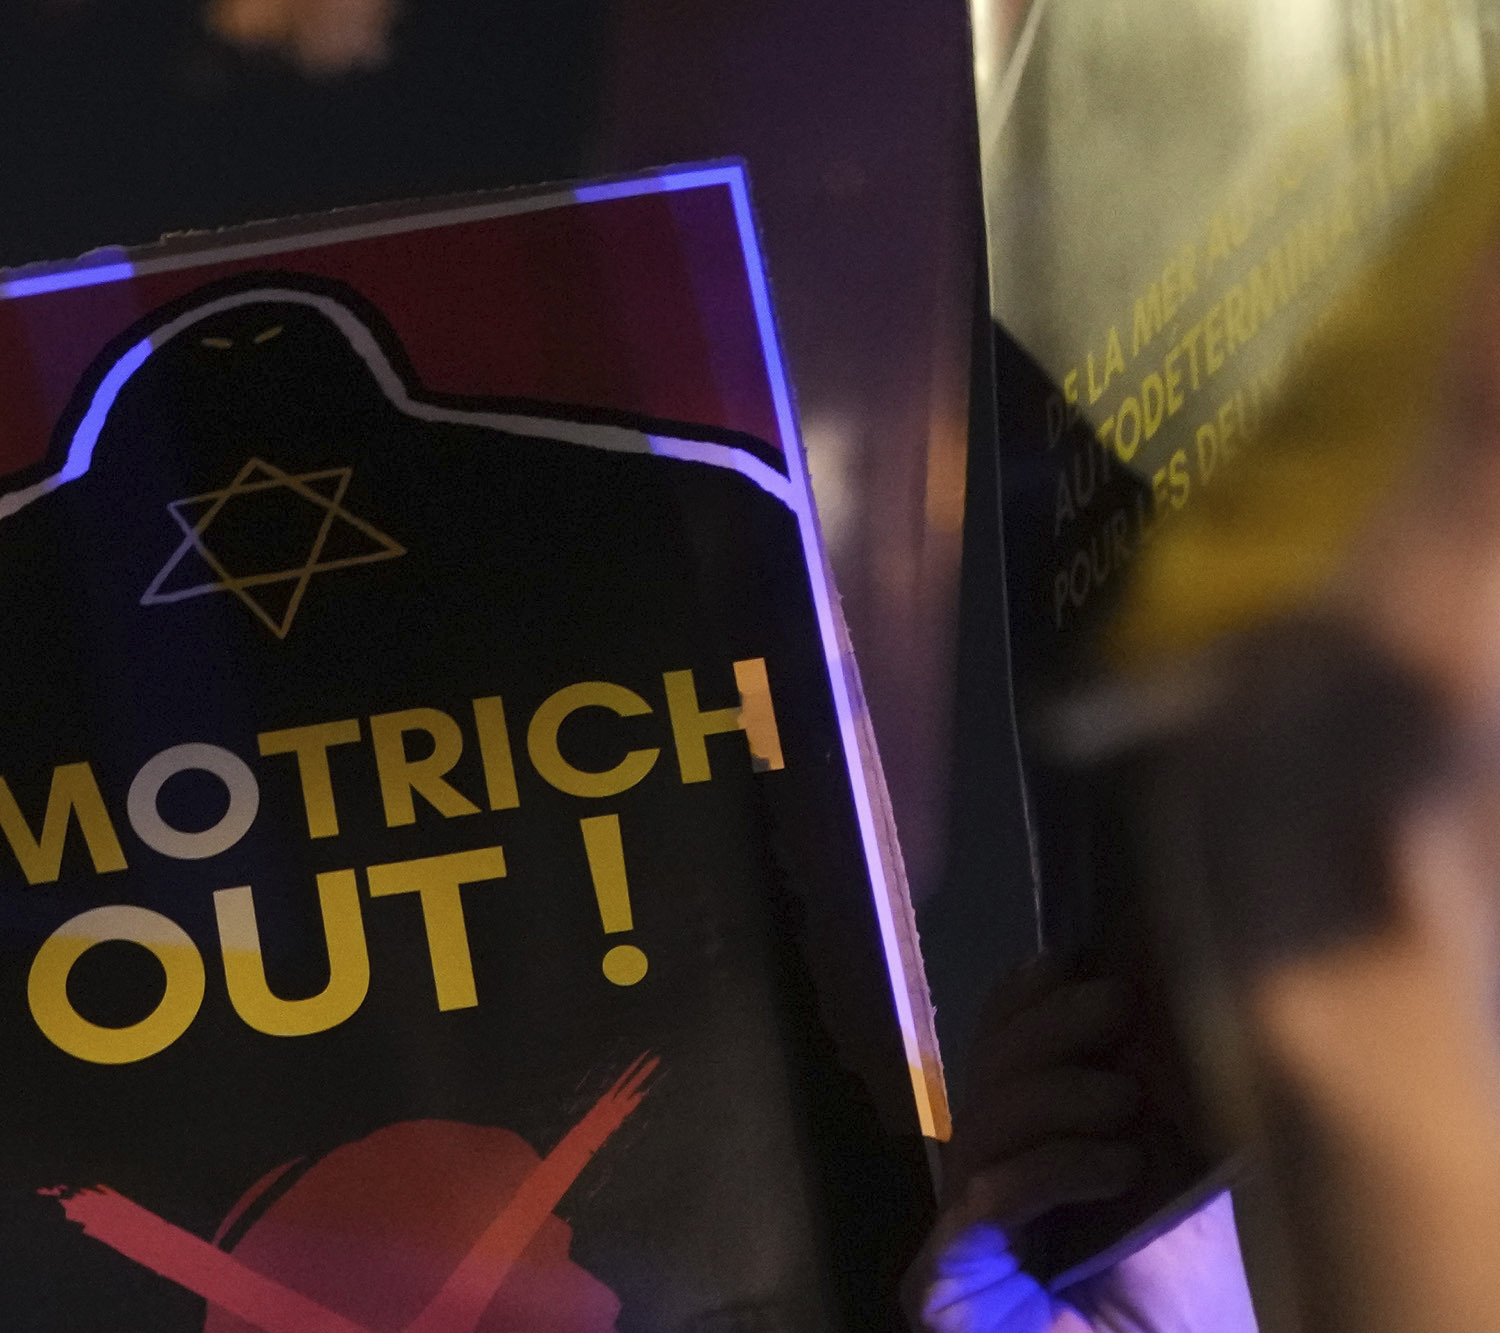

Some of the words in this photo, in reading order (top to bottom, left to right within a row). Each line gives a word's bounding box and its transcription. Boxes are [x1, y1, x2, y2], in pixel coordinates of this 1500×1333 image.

[1086, 326, 1126, 406] LA
[25, 846, 508, 1067] OUT
[579, 814, 650, 988] !
